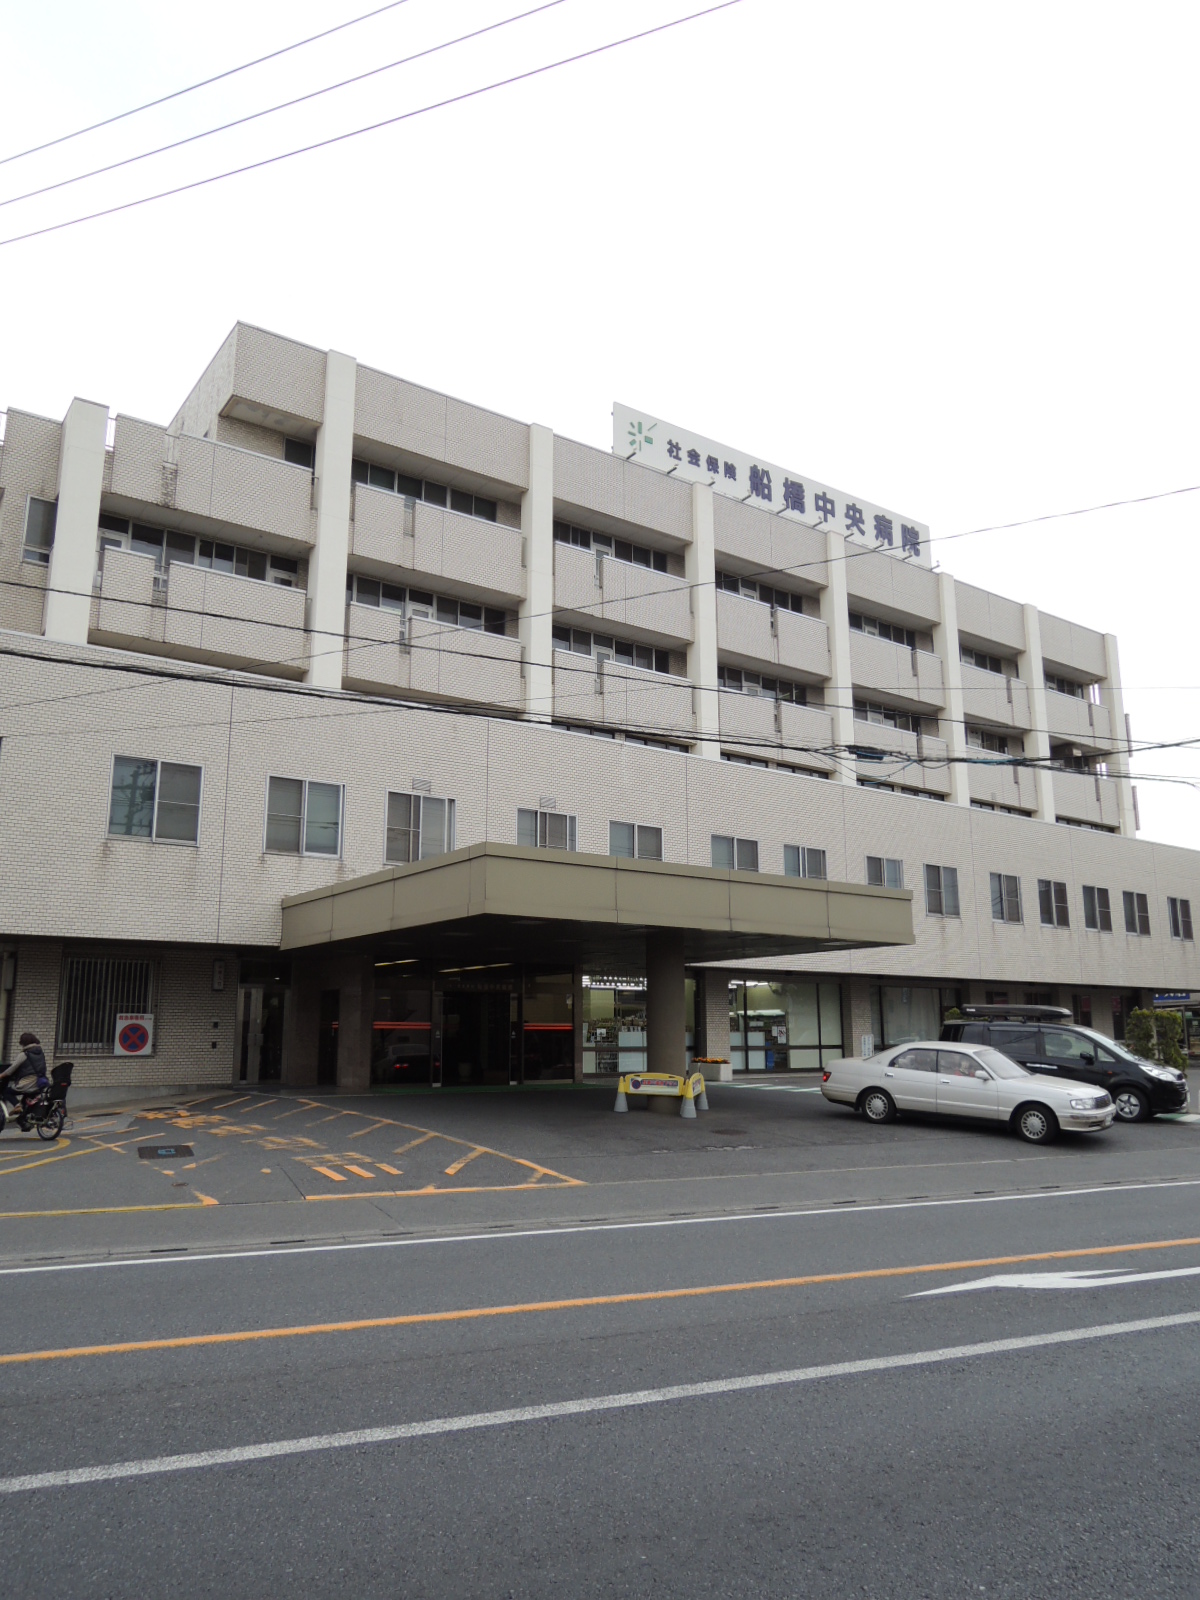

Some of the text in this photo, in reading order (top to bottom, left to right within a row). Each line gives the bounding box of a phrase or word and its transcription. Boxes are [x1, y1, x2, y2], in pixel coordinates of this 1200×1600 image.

[667, 439, 921, 557] 社会保険 船橋中央病院
